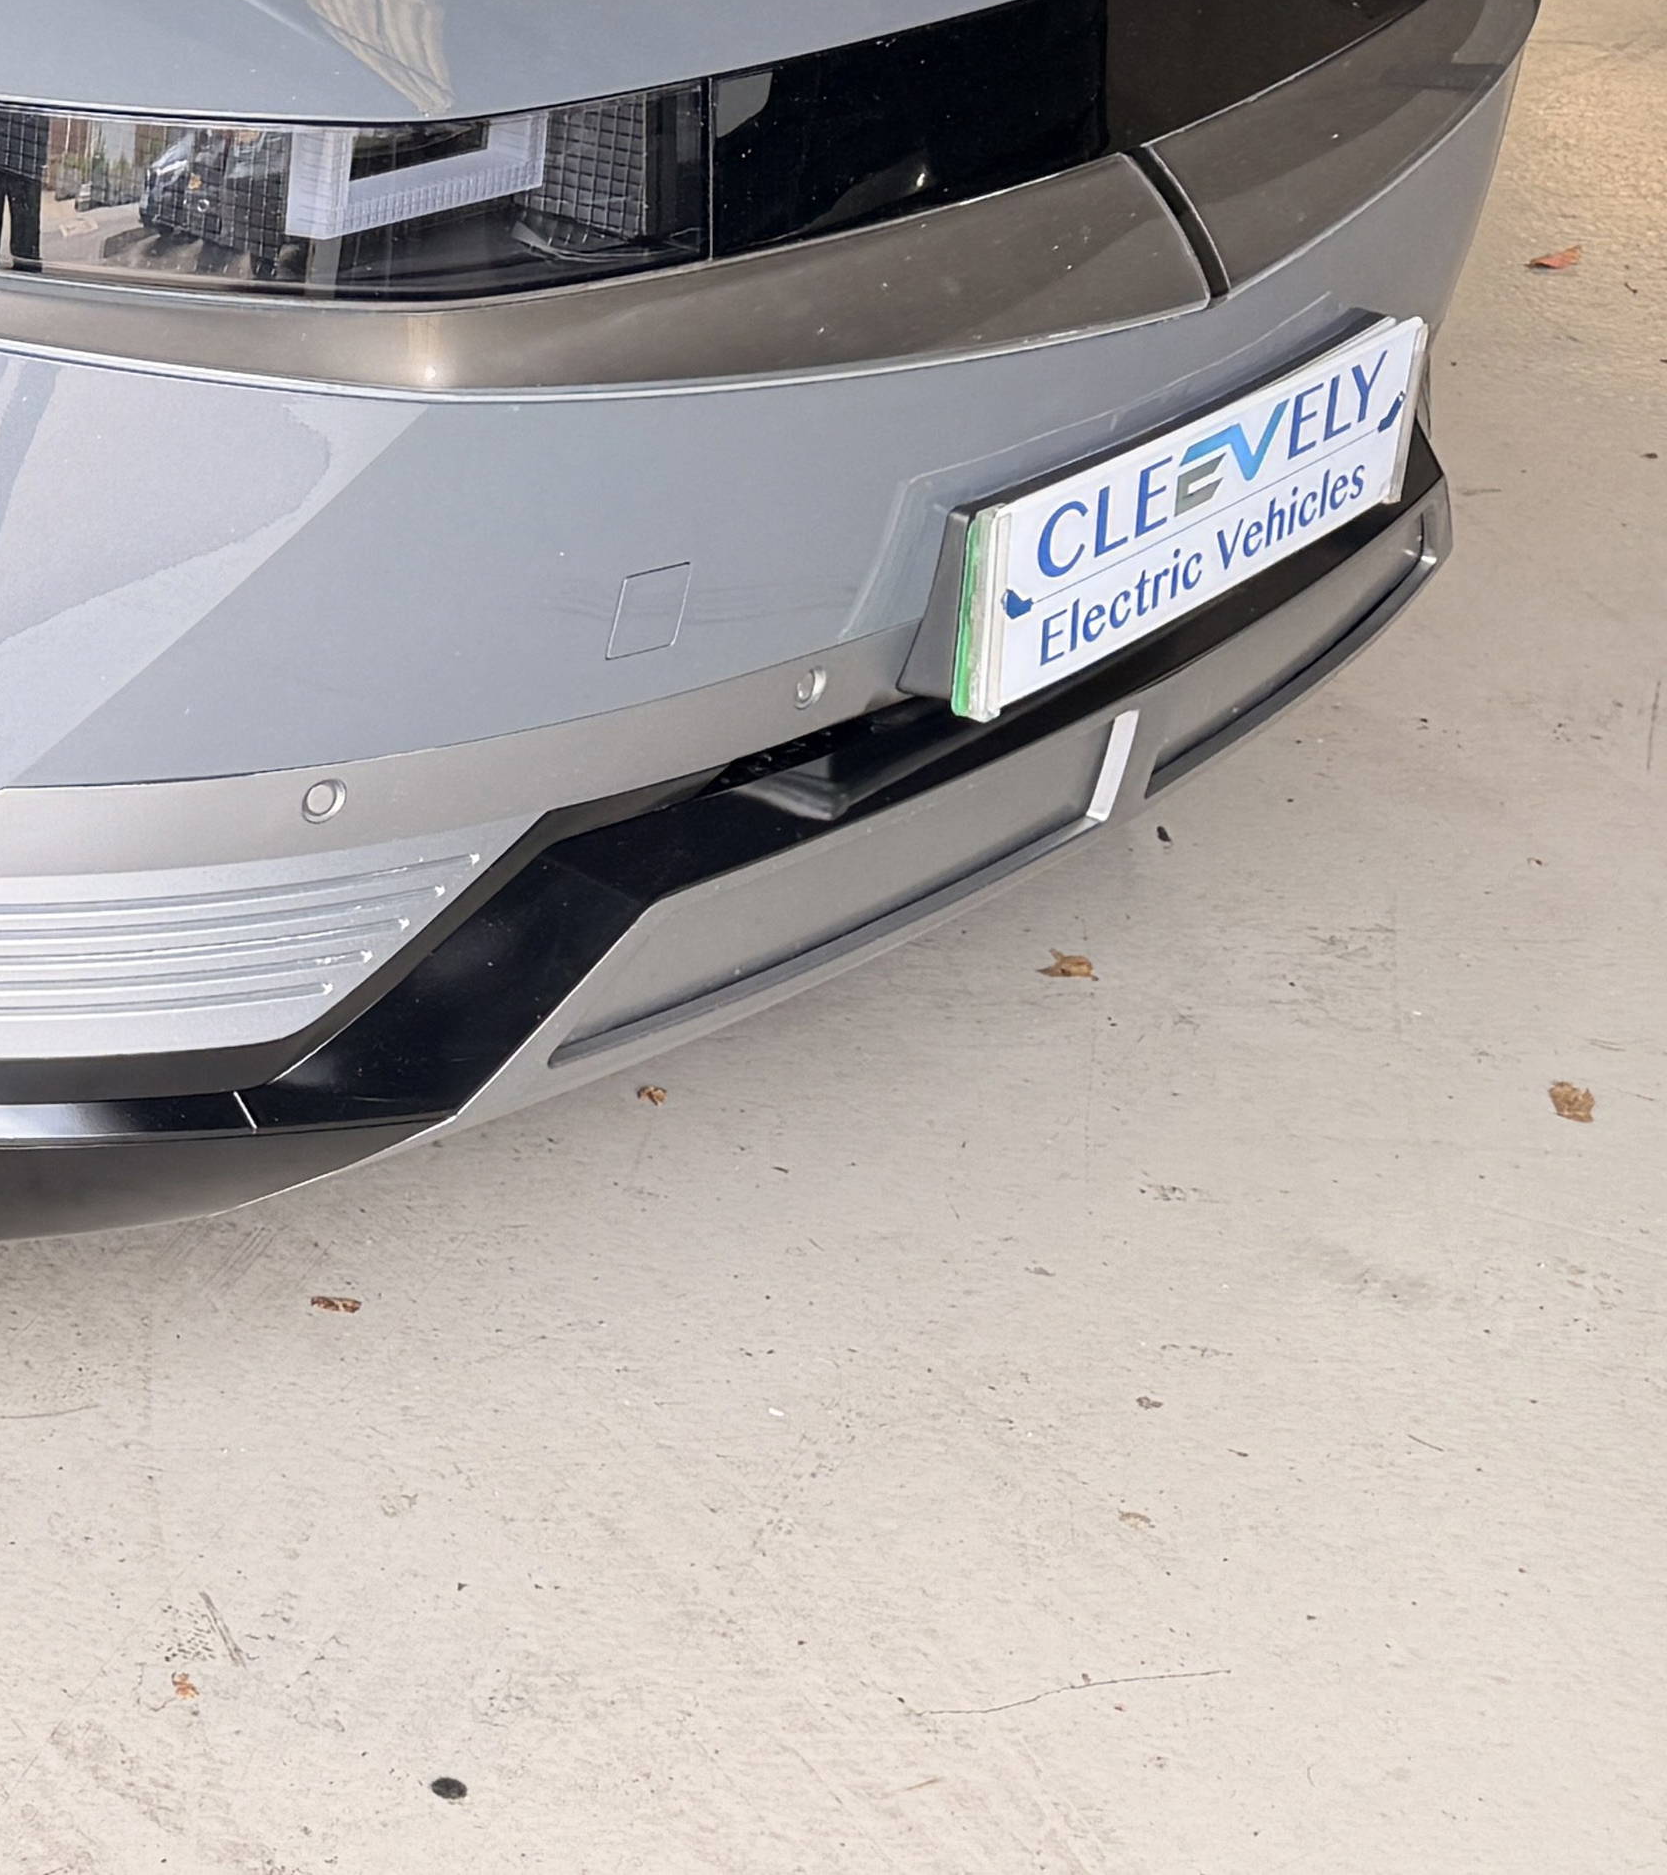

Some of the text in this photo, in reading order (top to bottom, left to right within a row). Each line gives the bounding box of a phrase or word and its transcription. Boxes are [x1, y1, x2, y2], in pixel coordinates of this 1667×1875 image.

[1036, 349, 1389, 579] CLEEVELY
[1039, 463, 1366, 667] Electric Vehicles
